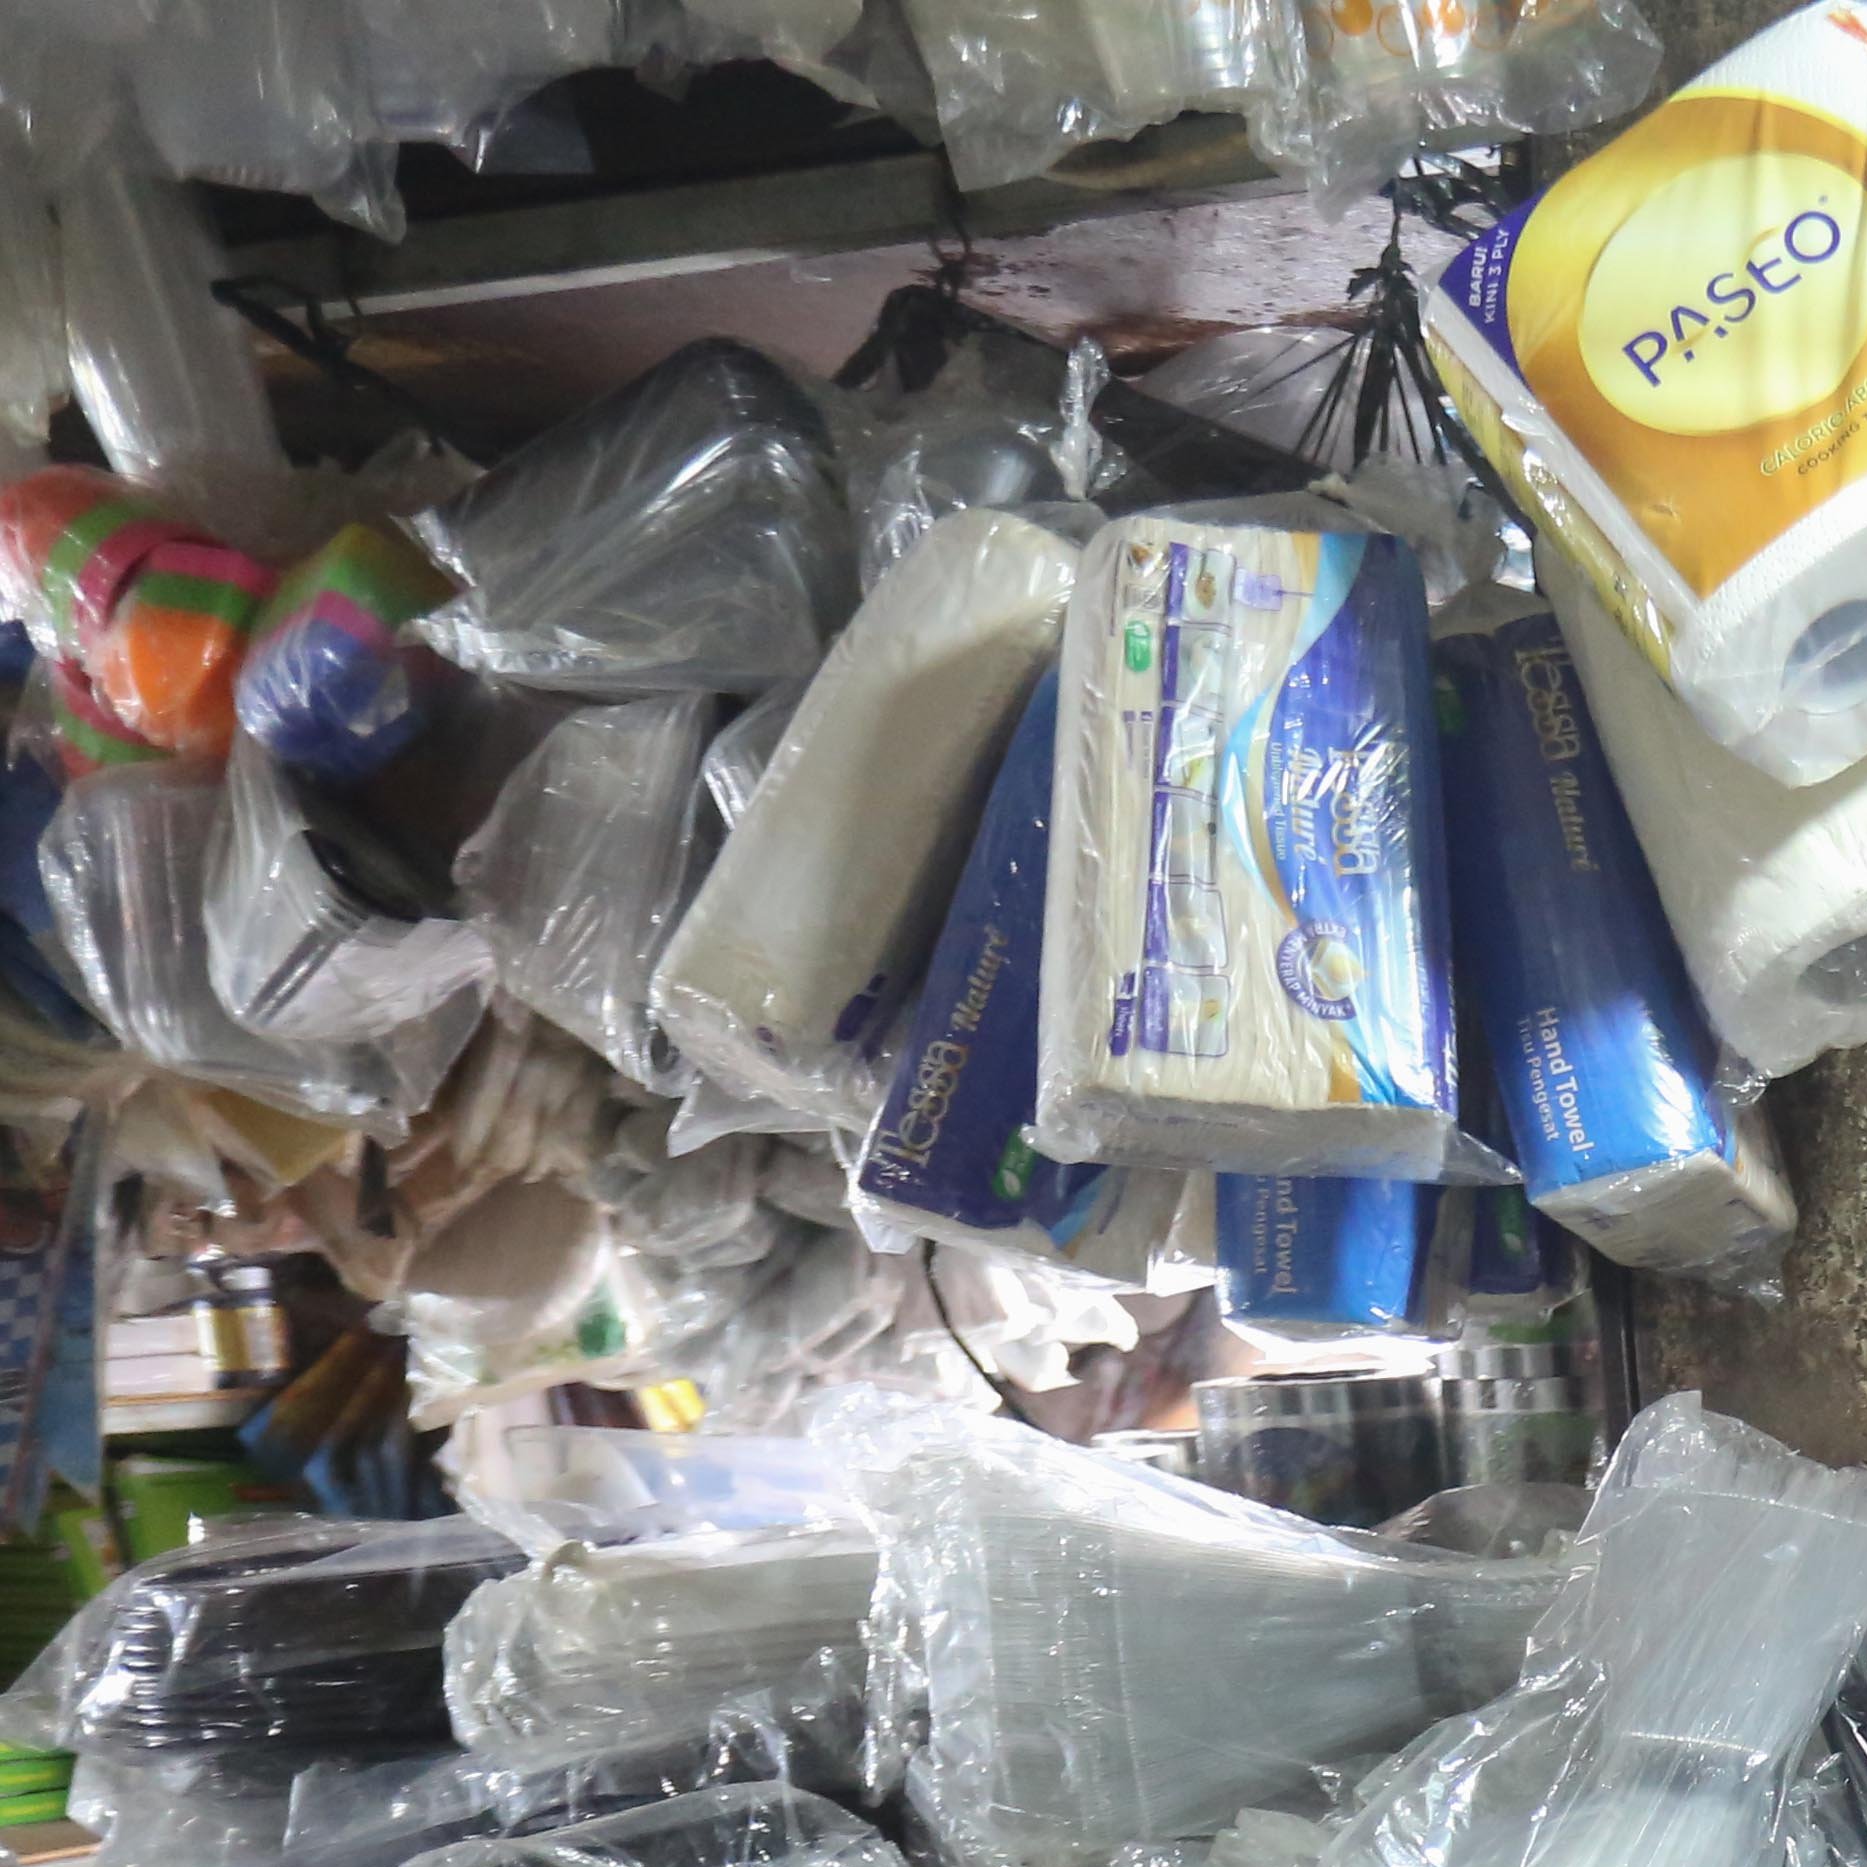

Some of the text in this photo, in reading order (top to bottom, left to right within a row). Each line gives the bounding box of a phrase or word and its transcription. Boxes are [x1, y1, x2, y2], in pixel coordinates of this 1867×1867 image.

[1468, 245, 1489, 308] BARU!
[1483, 227, 1511, 324] KINI 3 PLY
[1621, 209, 1842, 388] PASEO
[1797, 421, 1861, 477] COOKING
[896, 1033, 972, 1170] Tessa
[1525, 1057, 1560, 1143] Pengesat
[1534, 1006, 1594, 1160] Hand Towel
[1271, 1177, 1299, 1296] nd Towel
